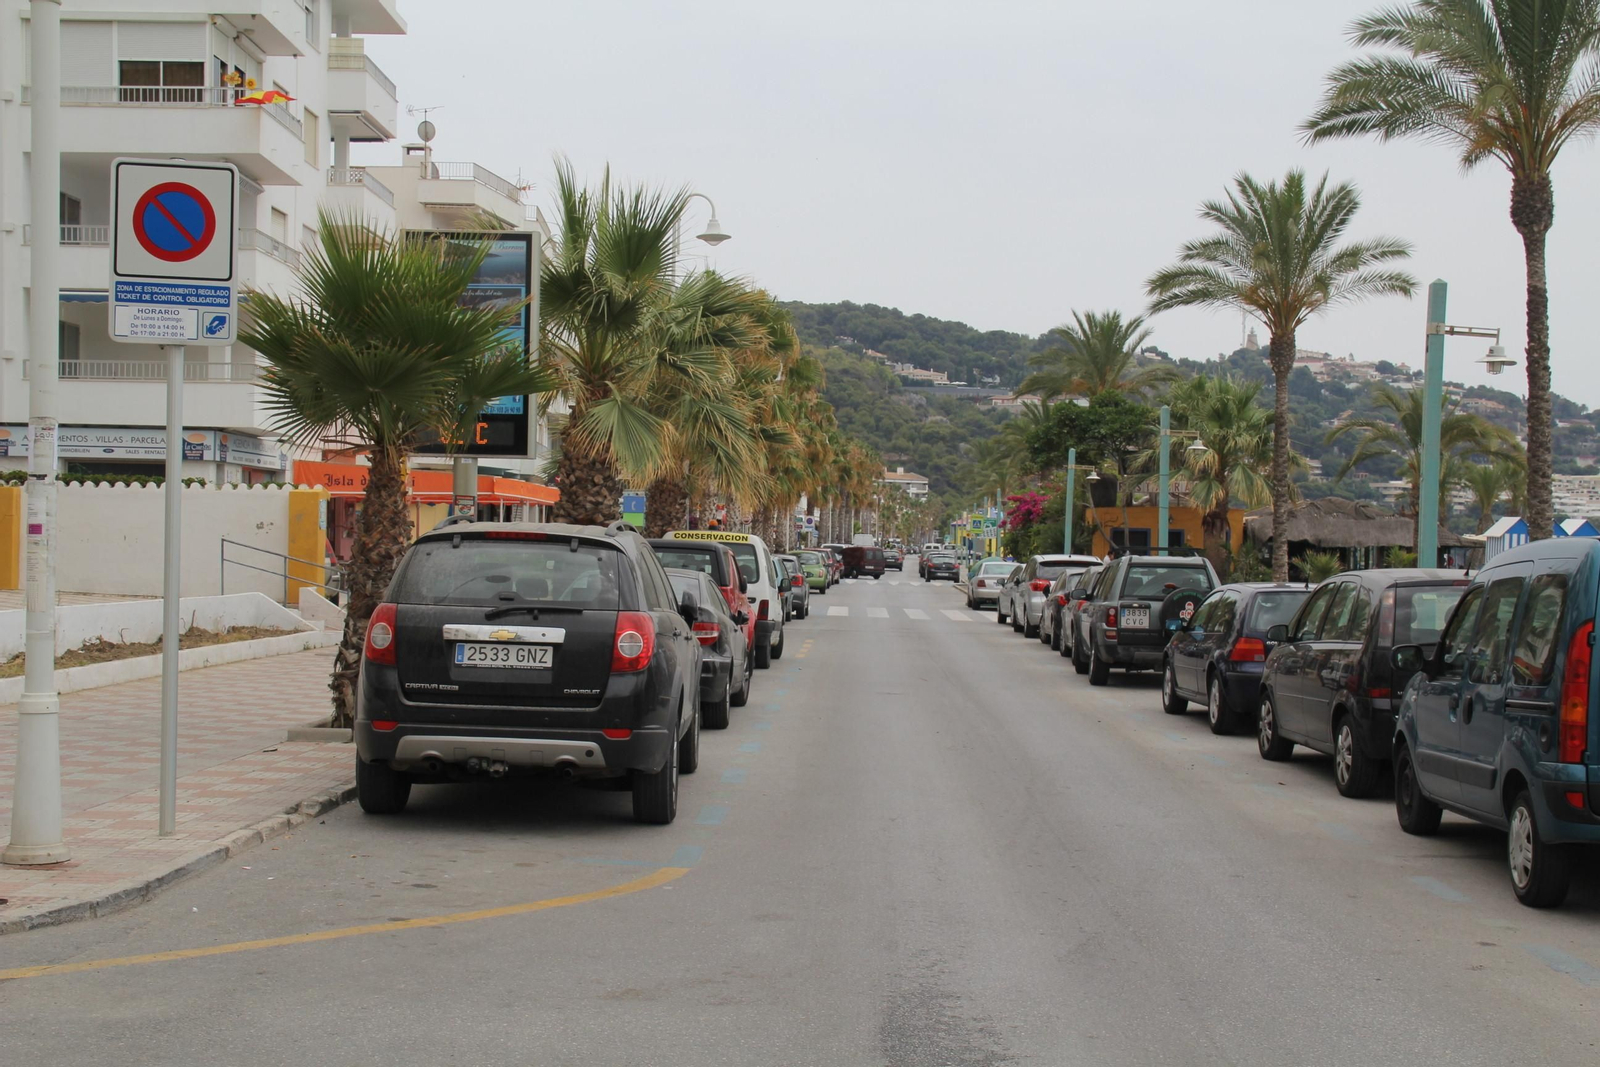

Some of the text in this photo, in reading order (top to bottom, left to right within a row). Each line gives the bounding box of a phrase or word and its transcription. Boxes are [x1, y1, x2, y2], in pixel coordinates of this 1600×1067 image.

[143, 286, 197, 295] ESTACIONAMIENTO
[186, 296, 228, 304] OBLIGATORIO
[137, 308, 180, 316] HORARIO
[95, 435, 123, 444] VILLAS
[324, 473, 354, 487] Isla
[674, 532, 749, 542] CONSERVACION
[1126, 609, 1148, 617] 3839
[467, 646, 548, 664] 2533 GNZ
[405, 682, 439, 690] CAPTIVA
